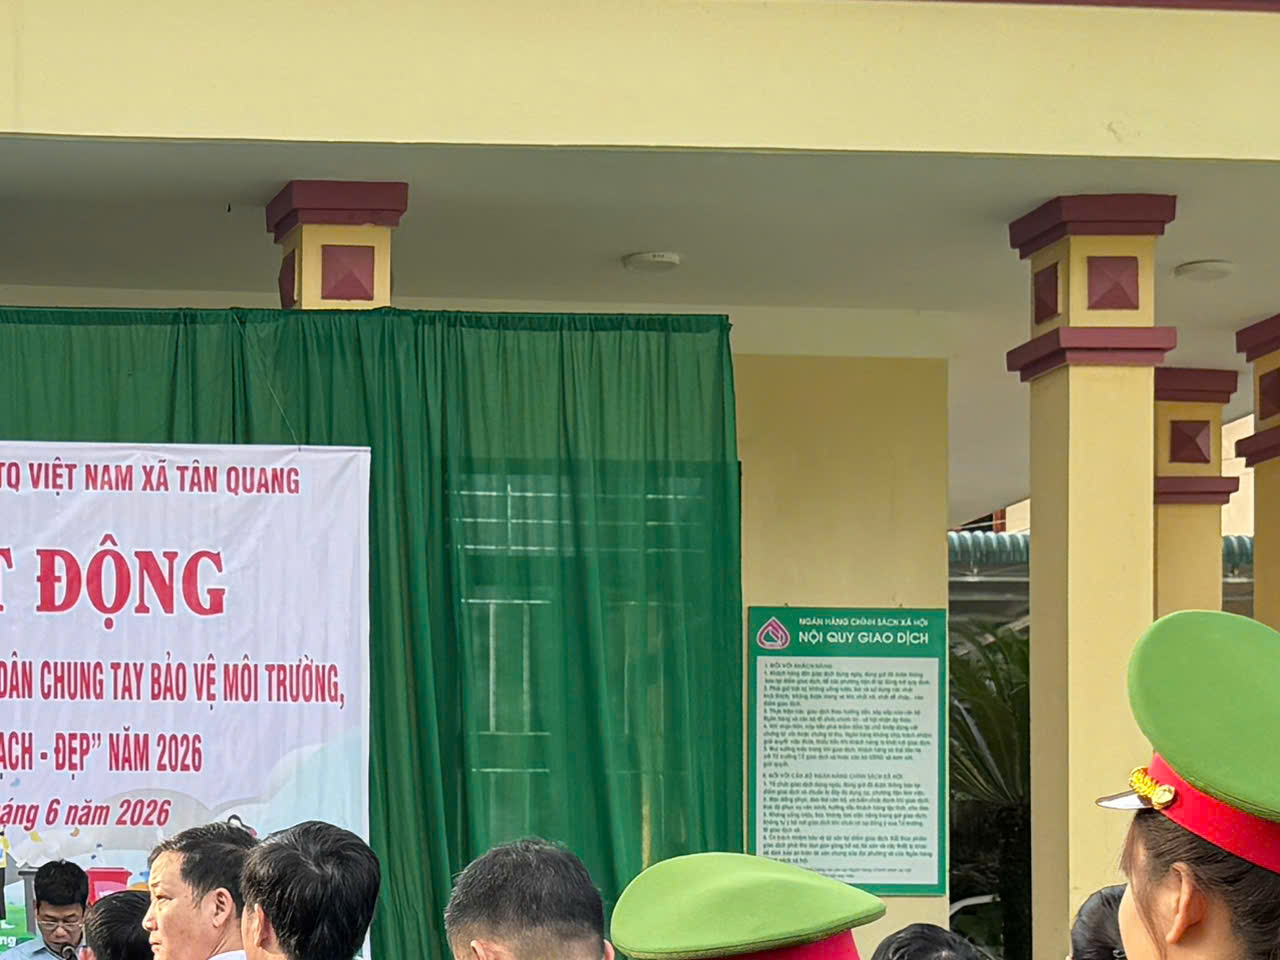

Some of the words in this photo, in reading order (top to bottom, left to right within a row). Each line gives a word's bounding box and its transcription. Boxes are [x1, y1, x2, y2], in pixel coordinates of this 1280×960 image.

[28, 456, 78, 496] VIỆT
[84, 463, 133, 491] NAM
[141, 459, 169, 492] XÃ
[175, 459, 218, 493] TÂN
[226, 466, 300, 496] QUANG
[36, 533, 226, 630] ĐỘNG
[798, 628, 823, 644] NỘI
[826, 631, 855, 644] QUY
[857, 631, 894, 644] GIAO
[897, 630, 929, 646] DỊCH
[40, 660, 104, 701] CHUNG
[110, 662, 145, 701] TAY
[150, 651, 187, 702] BẢO
[193, 653, 217, 711] VỆ
[223, 654, 259, 702] MÔI
[264, 654, 345, 710] TRƯỜNG,
[53, 732, 101, 781] ĐẸP”
[108, 726, 150, 772] NĂM
[156, 733, 202, 772] 2026
[45, 798, 61, 826] 6
[64, 799, 111, 826] năm
[115, 798, 172, 827] 2026
